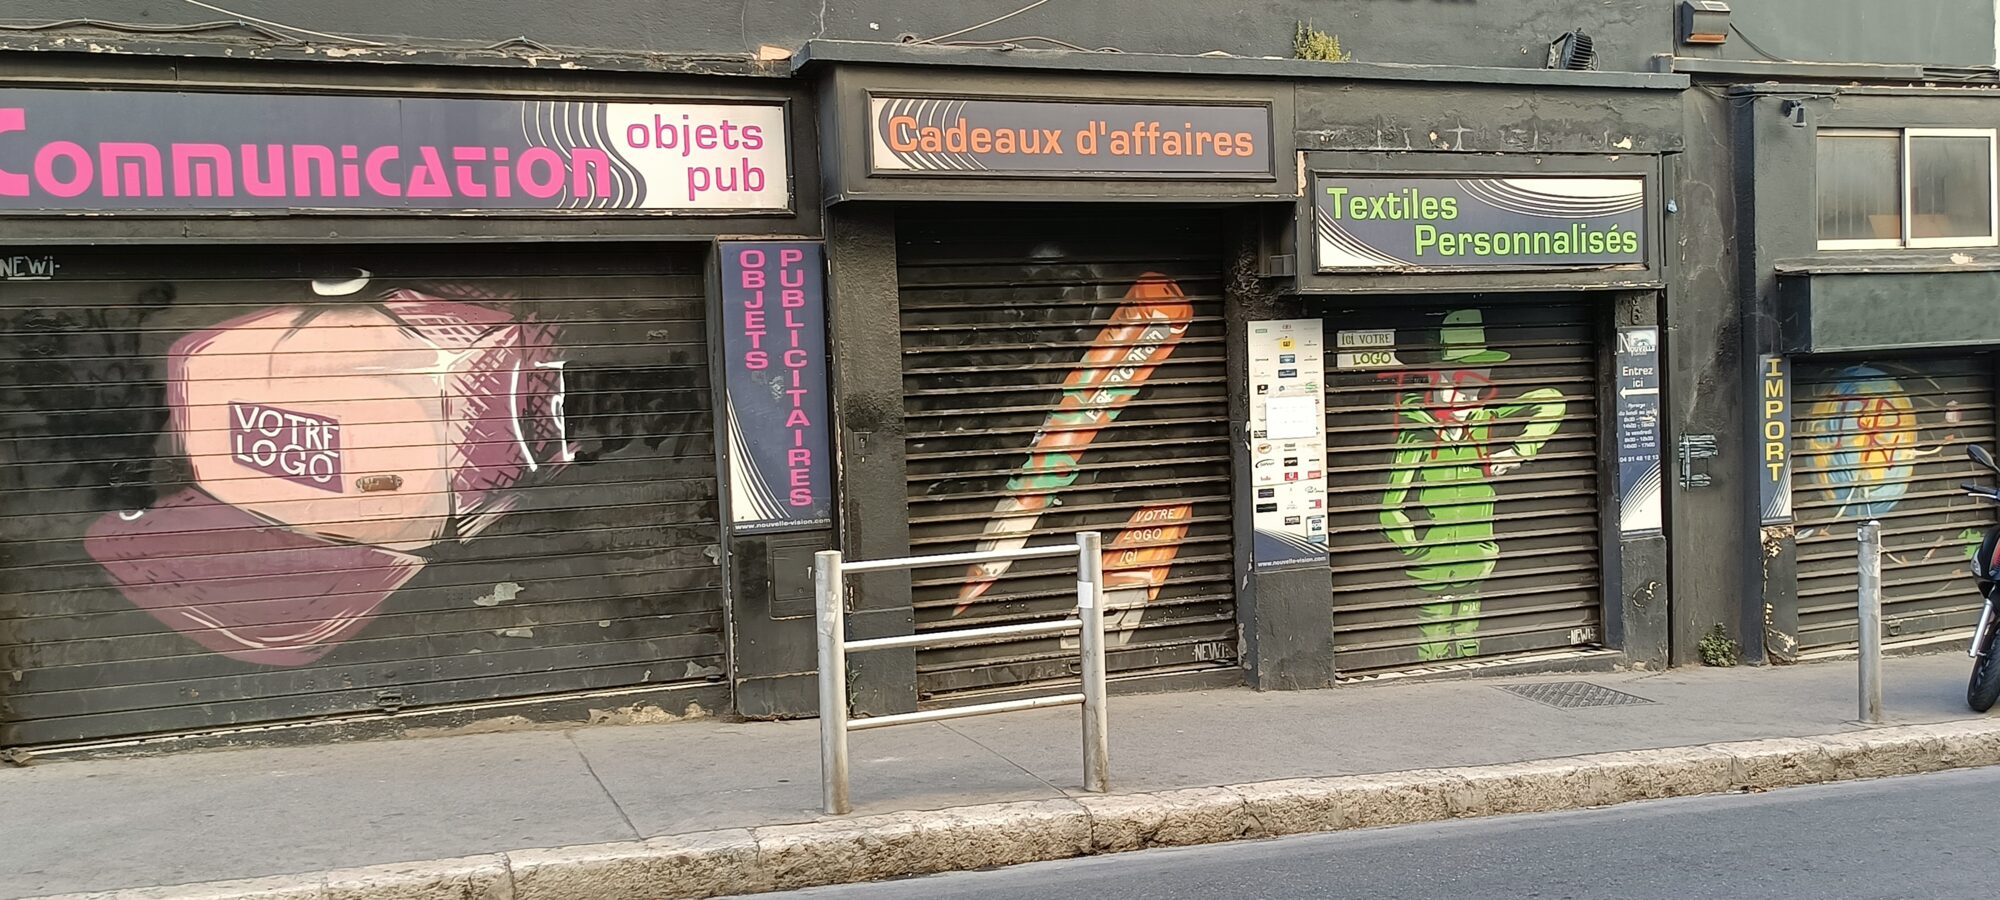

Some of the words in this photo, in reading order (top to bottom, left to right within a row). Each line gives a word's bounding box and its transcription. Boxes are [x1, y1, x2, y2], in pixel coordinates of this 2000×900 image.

[626, 114, 764, 158] objets
[888, 115, 1064, 155] Cadeaux
[1076, 120, 1254, 158] d'affaires
[687, 157, 766, 201] pub
[1326, 187, 1459, 220] Textiles
[1414, 223, 1639, 256] Personnalisés
[739, 249, 769, 370] OBJETS
[1359, 333, 1392, 345] VOTRE
[1353, 352, 1392, 366] LOGO
[1622, 366, 1654, 377] Entrez
[779, 249, 812, 507] PUBLICITAIRES
[1632, 378, 1644, 388] ici
[234, 404, 339, 458] VOTRE
[1764, 358, 1785, 481] IMPORT
[236, 434, 334, 483] LOGO
[734, 518, 831, 531] www.nouvelle-vision.com
[1135, 508, 1176, 522] VOTRE
[1123, 528, 1163, 542] LOGO
